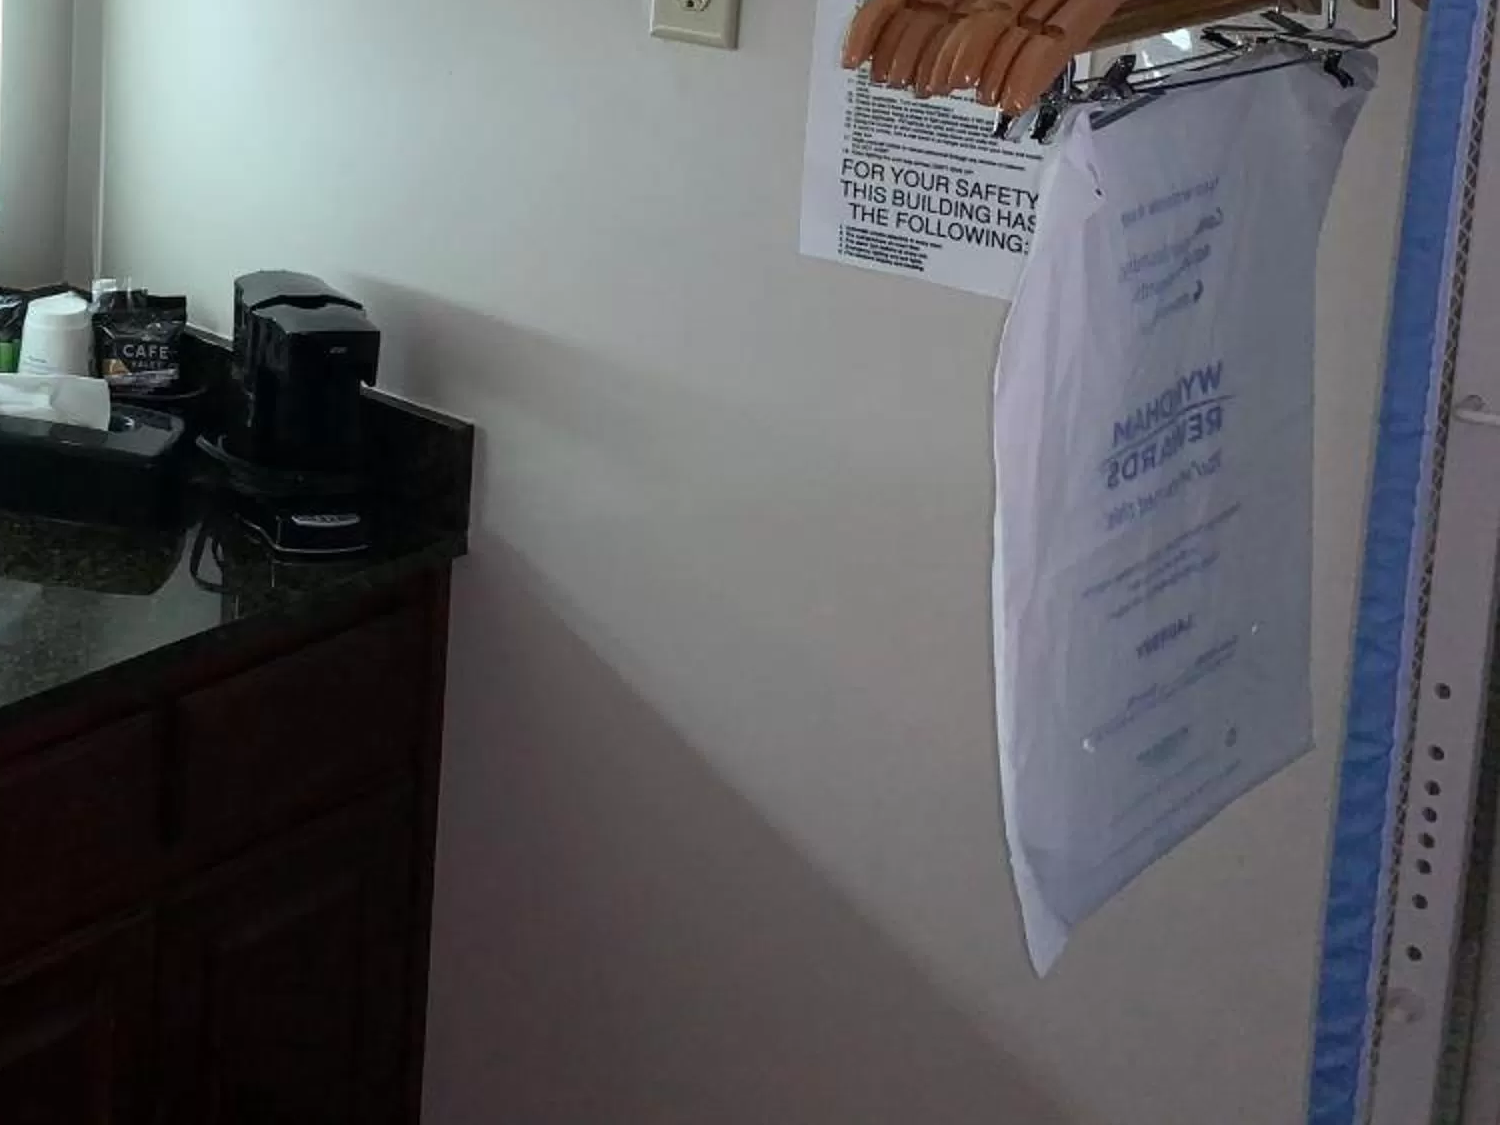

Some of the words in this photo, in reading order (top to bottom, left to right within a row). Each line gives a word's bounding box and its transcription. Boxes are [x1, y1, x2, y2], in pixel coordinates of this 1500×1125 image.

[840, 179, 887, 204] THIS
[892, 190, 990, 224] BUILDING
[841, 158, 885, 181] FOR
[891, 167, 949, 194] YOUR
[955, 178, 1039, 209] SAFETY
[848, 202, 889, 226] THE
[896, 212, 1029, 255] FOLLOWING:
[122, 344, 169, 360] CAFE
